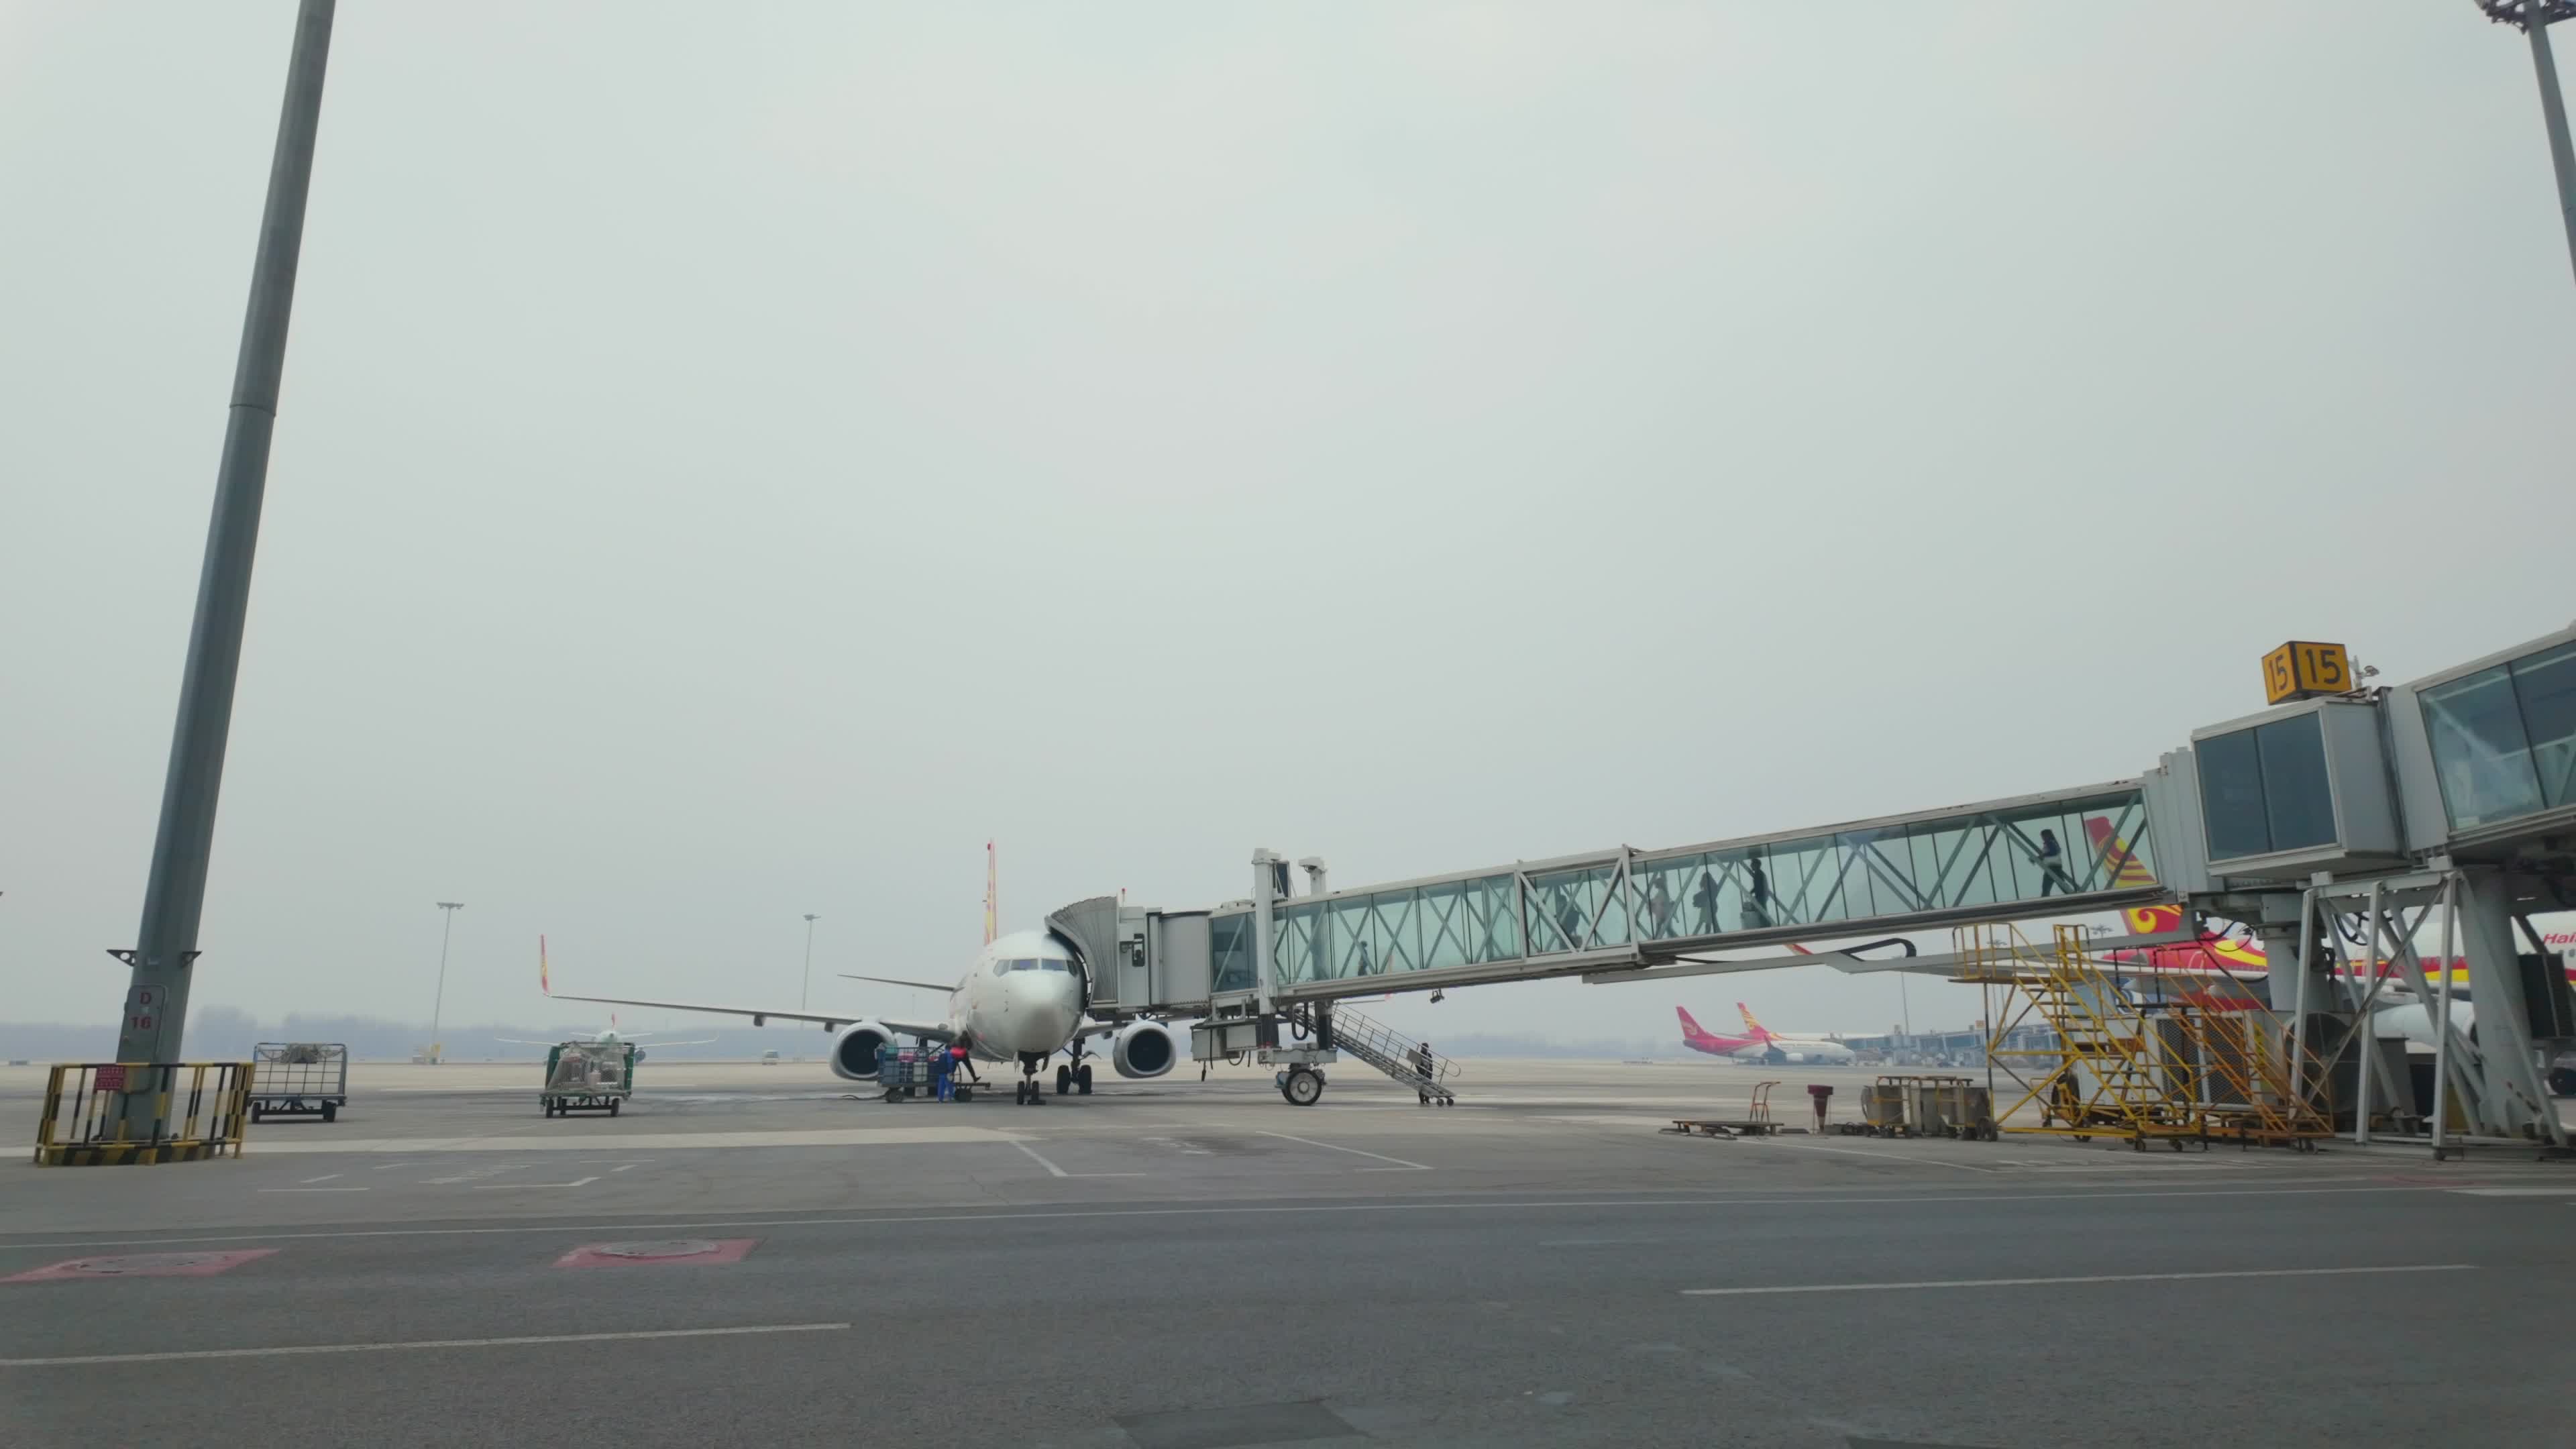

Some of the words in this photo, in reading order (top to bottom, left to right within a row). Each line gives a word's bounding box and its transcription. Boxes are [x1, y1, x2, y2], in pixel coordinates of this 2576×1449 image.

[2269, 655, 2288, 694] 15
[2306, 649, 2341, 684] 15
[2543, 932, 2576, 945] Hai
[140, 992, 152, 1004] D
